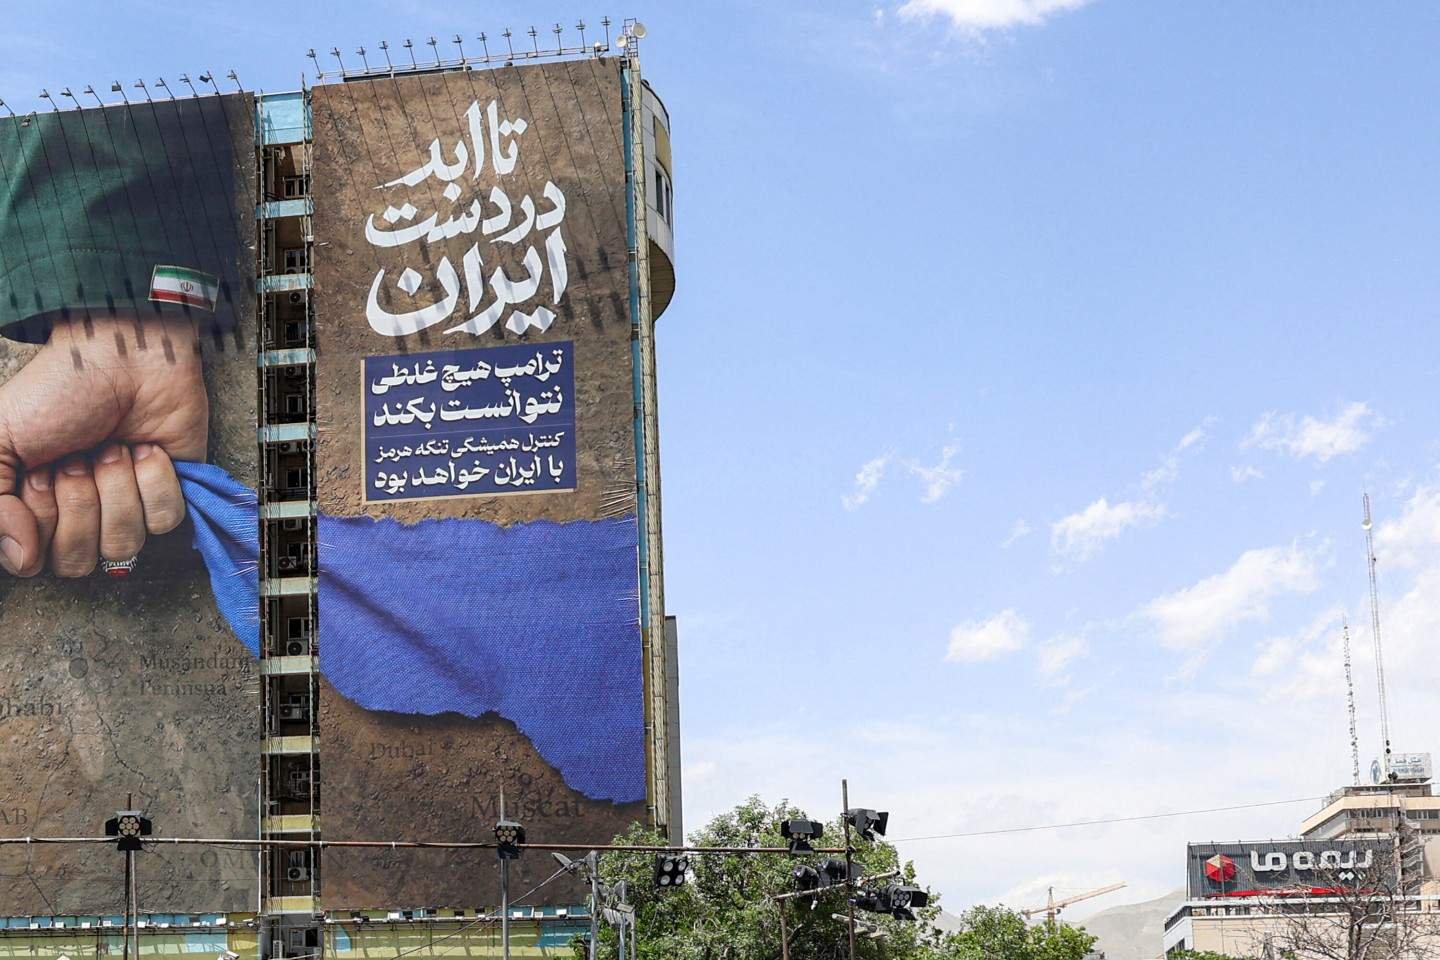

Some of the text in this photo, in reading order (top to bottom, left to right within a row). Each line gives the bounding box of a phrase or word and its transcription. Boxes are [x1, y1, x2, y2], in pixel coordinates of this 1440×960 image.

[373, 99, 528, 202] تا ابد
[365, 181, 566, 247] در دست
[365, 226, 568, 336] ایران
[371, 349, 564, 394] ترامپ هیچ غلطی
[373, 385, 564, 430] نتوانست بکند
[373, 431, 565, 463] کنترل همیشگی تنگه هرمز
[374, 454, 564, 494] با ایران خواهد بود
